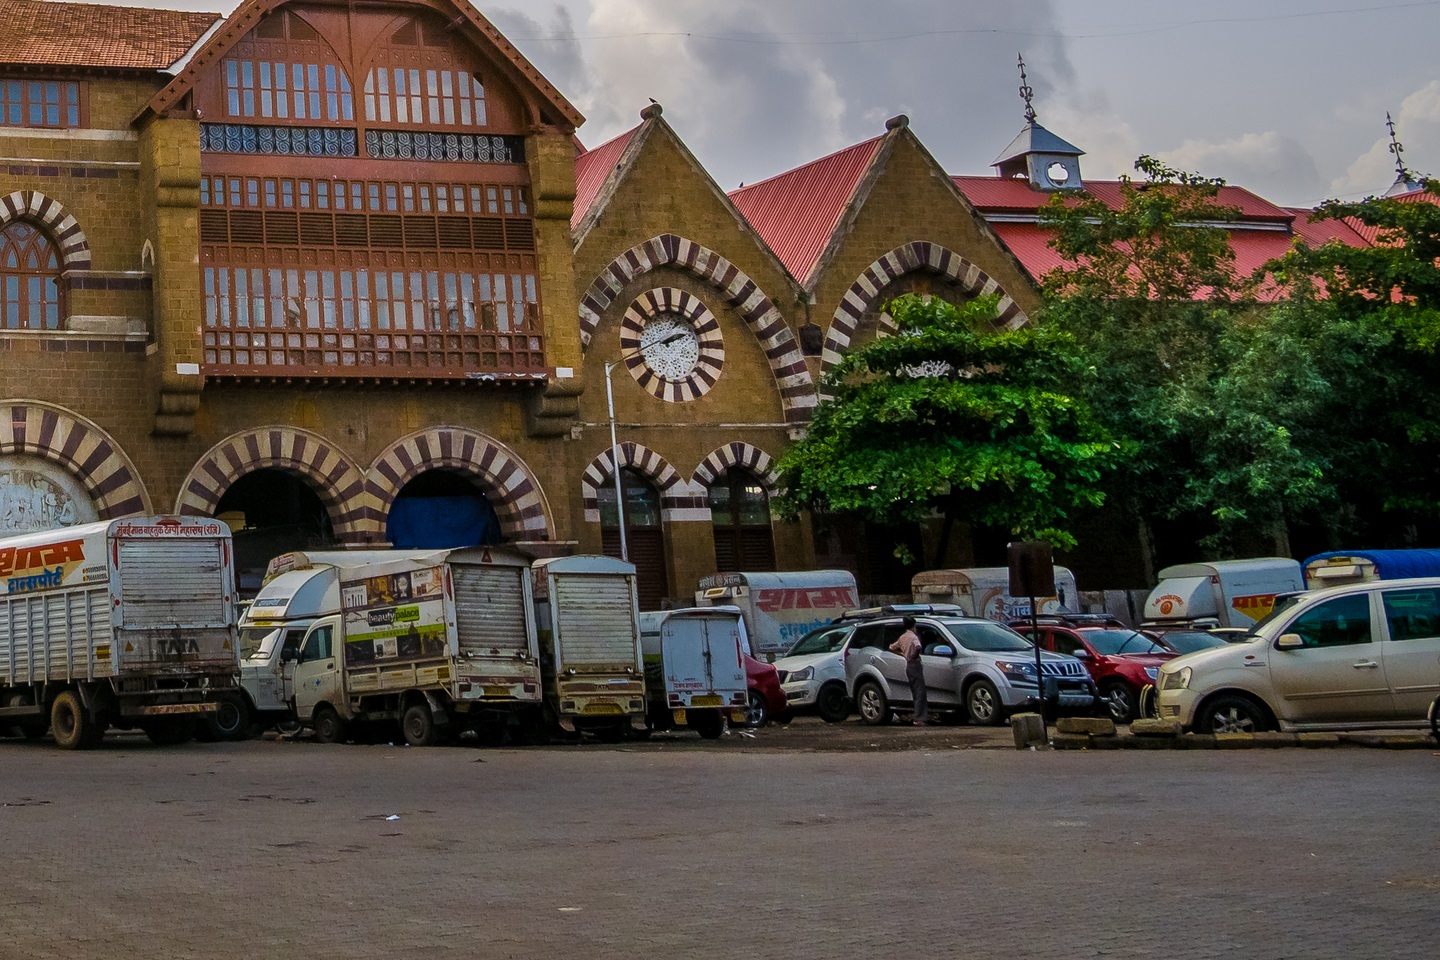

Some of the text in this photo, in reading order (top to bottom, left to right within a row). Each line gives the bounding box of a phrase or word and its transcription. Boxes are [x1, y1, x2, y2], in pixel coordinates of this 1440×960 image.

[368, 608, 419, 624] beauty palace
[157, 638, 200, 653] TATA
